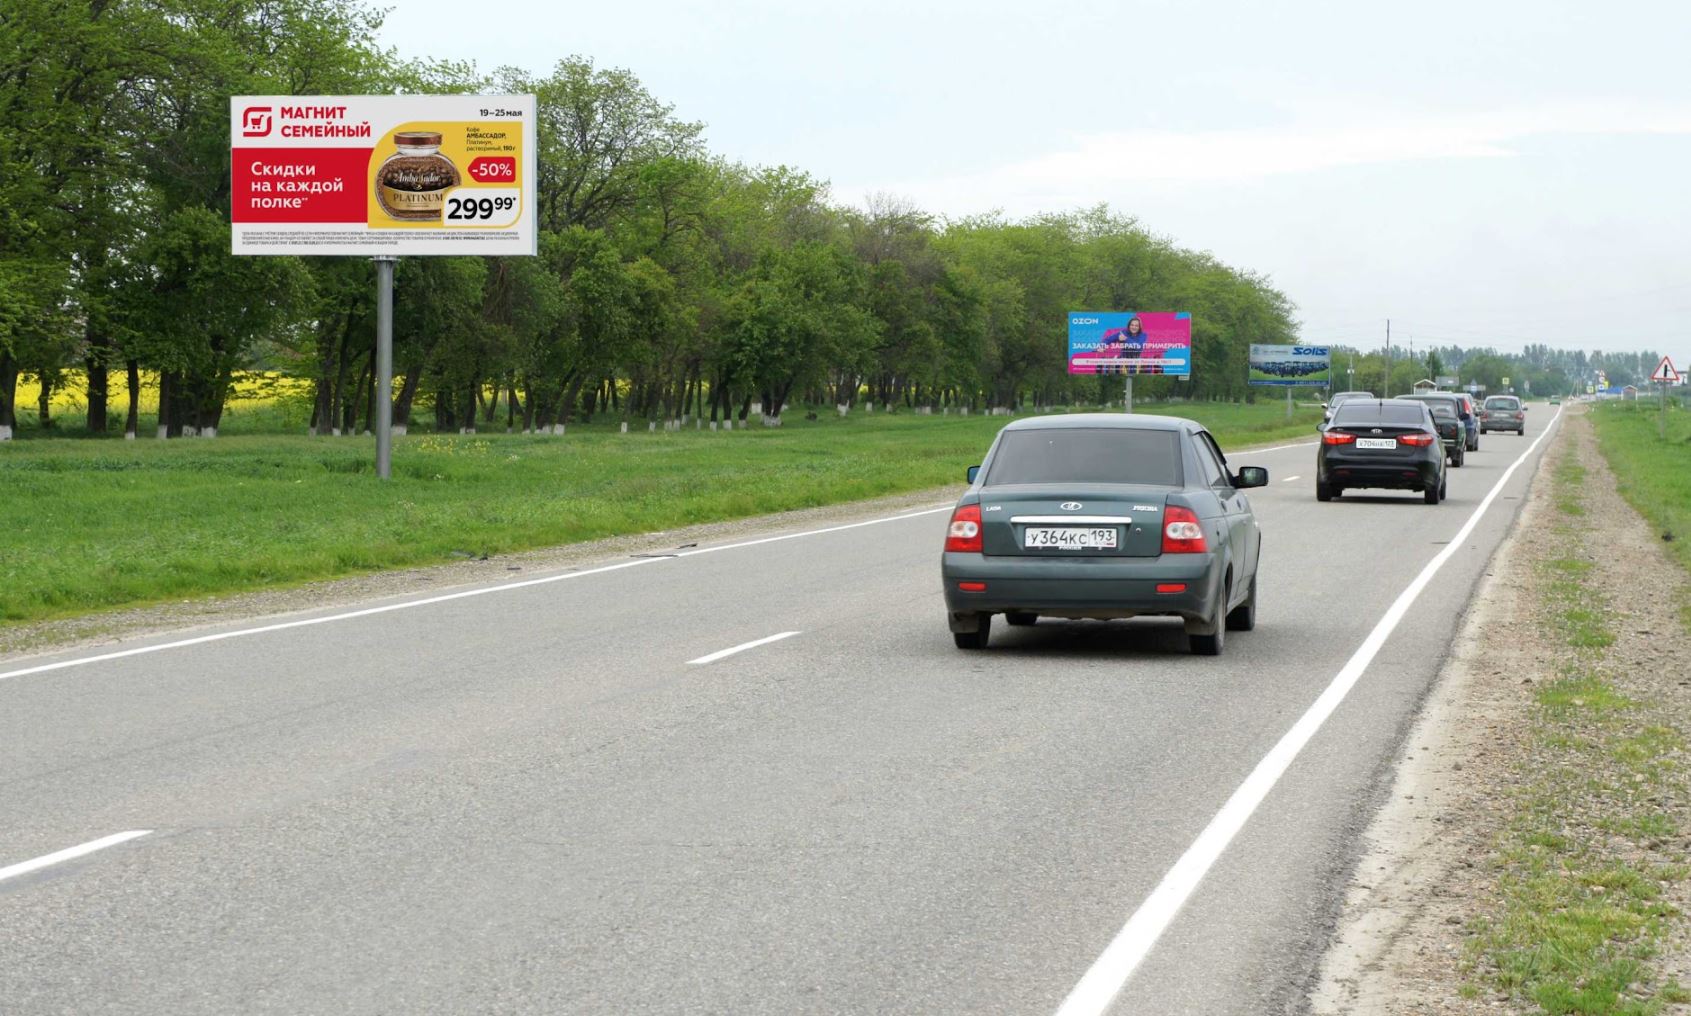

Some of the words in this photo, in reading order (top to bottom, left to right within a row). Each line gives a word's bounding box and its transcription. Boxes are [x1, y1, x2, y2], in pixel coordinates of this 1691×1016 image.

[280, 107, 347, 119] МАГНИТ
[281, 122, 371, 138] СЕМЕЙНЫЙ
[251, 161, 316, 176] Скидки
[471, 163, 512, 177] -50%
[251, 182, 272, 192] на
[276, 177, 343, 195] каждой
[393, 193, 443, 202] PLATINUM
[1091, 530, 1112, 541] 193
